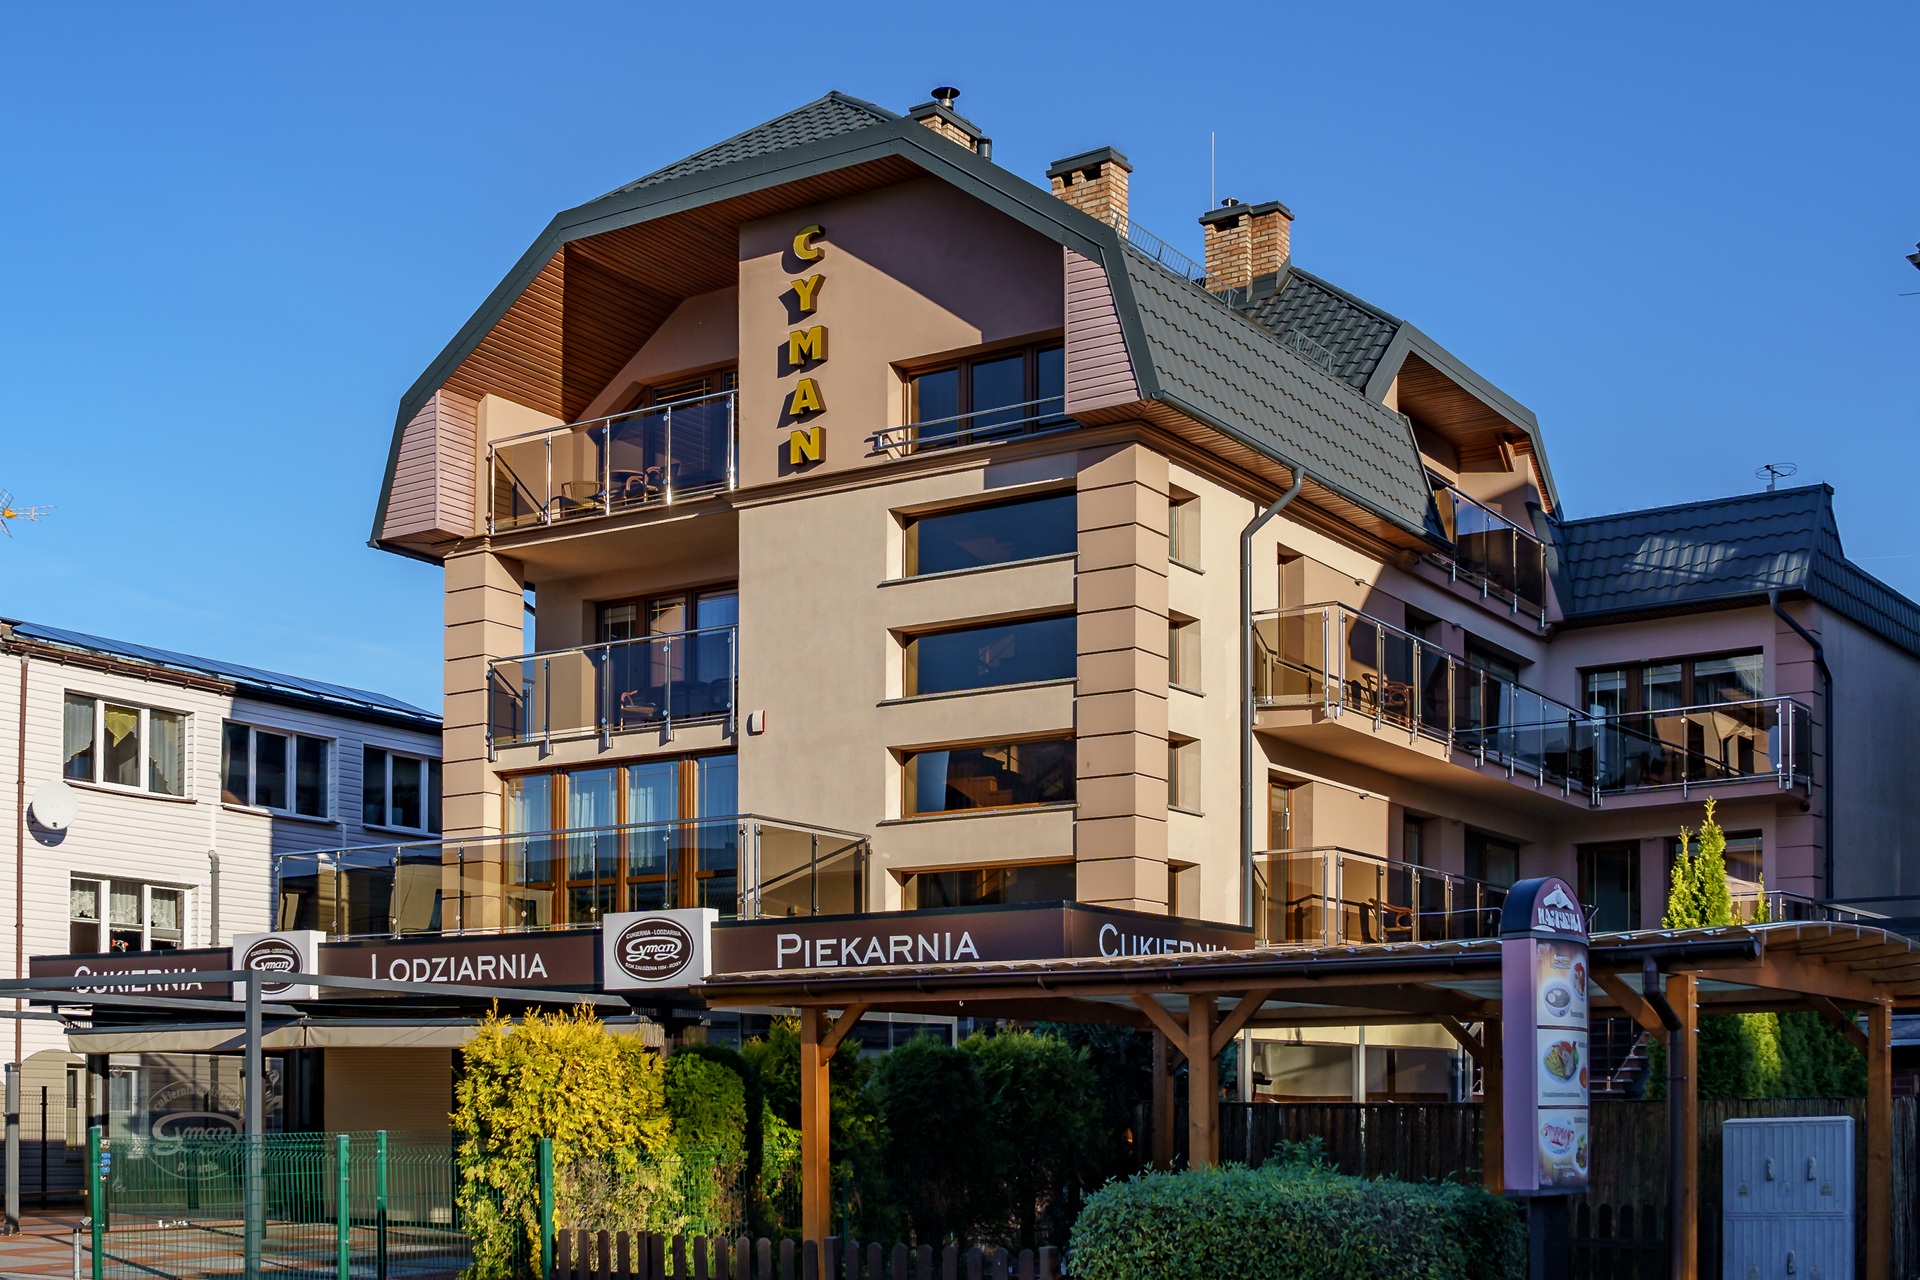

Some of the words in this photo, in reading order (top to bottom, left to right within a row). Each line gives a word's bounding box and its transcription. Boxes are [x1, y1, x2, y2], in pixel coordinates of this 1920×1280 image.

[789, 224, 828, 465] CYMAN
[625, 929, 651, 940] CUKIERNIA
[653, 929, 682, 937] LODZIARNIA
[777, 931, 980, 968] PIEKARNIA
[371, 953, 548, 983] LODZIARNIA
